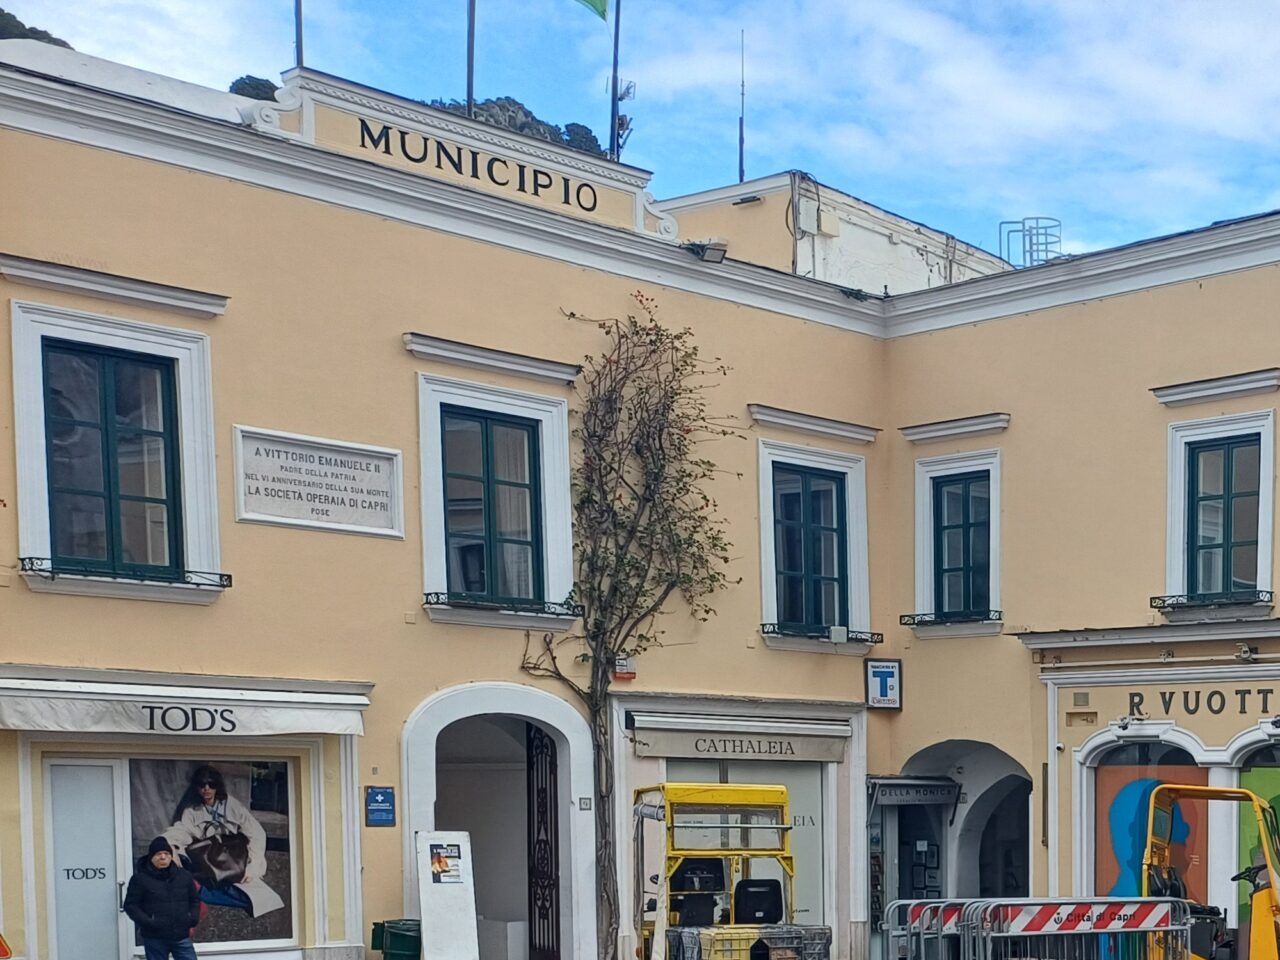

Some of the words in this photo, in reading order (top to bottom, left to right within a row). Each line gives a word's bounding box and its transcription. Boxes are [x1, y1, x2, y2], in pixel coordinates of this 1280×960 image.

[358, 118, 597, 212] MUNICIPIO
[255, 447, 261, 456] A
[264, 448, 315, 463] VITTORIO
[319, 456, 371, 472] EMANUELE
[375, 464, 380, 473] II
[280, 465, 303, 474] PADRE
[305, 469, 328, 478] DELLA
[331, 472, 356, 481] PATRIA
[245, 473, 259, 481] NEL
[271, 477, 323, 489] ANNIVERSARIO
[326, 483, 347, 492] DELLA
[367, 489, 389, 497] MORTE
[248, 486, 261, 496] LA
[264, 488, 303, 501] SOCIETÀ
[307, 493, 346, 506] OPERAIA
[349, 498, 358, 508] DI
[361, 500, 388, 512] CAPRI
[311, 508, 330, 516] POSE
[142, 705, 236, 732] TOD'S
[695, 739, 795, 755] CATHALEIA
[63, 868, 106, 880] TOD'S
[1066, 912, 1091, 922] Città
[1095, 911, 1104, 921] di
[1109, 911, 1135, 923] Capri
